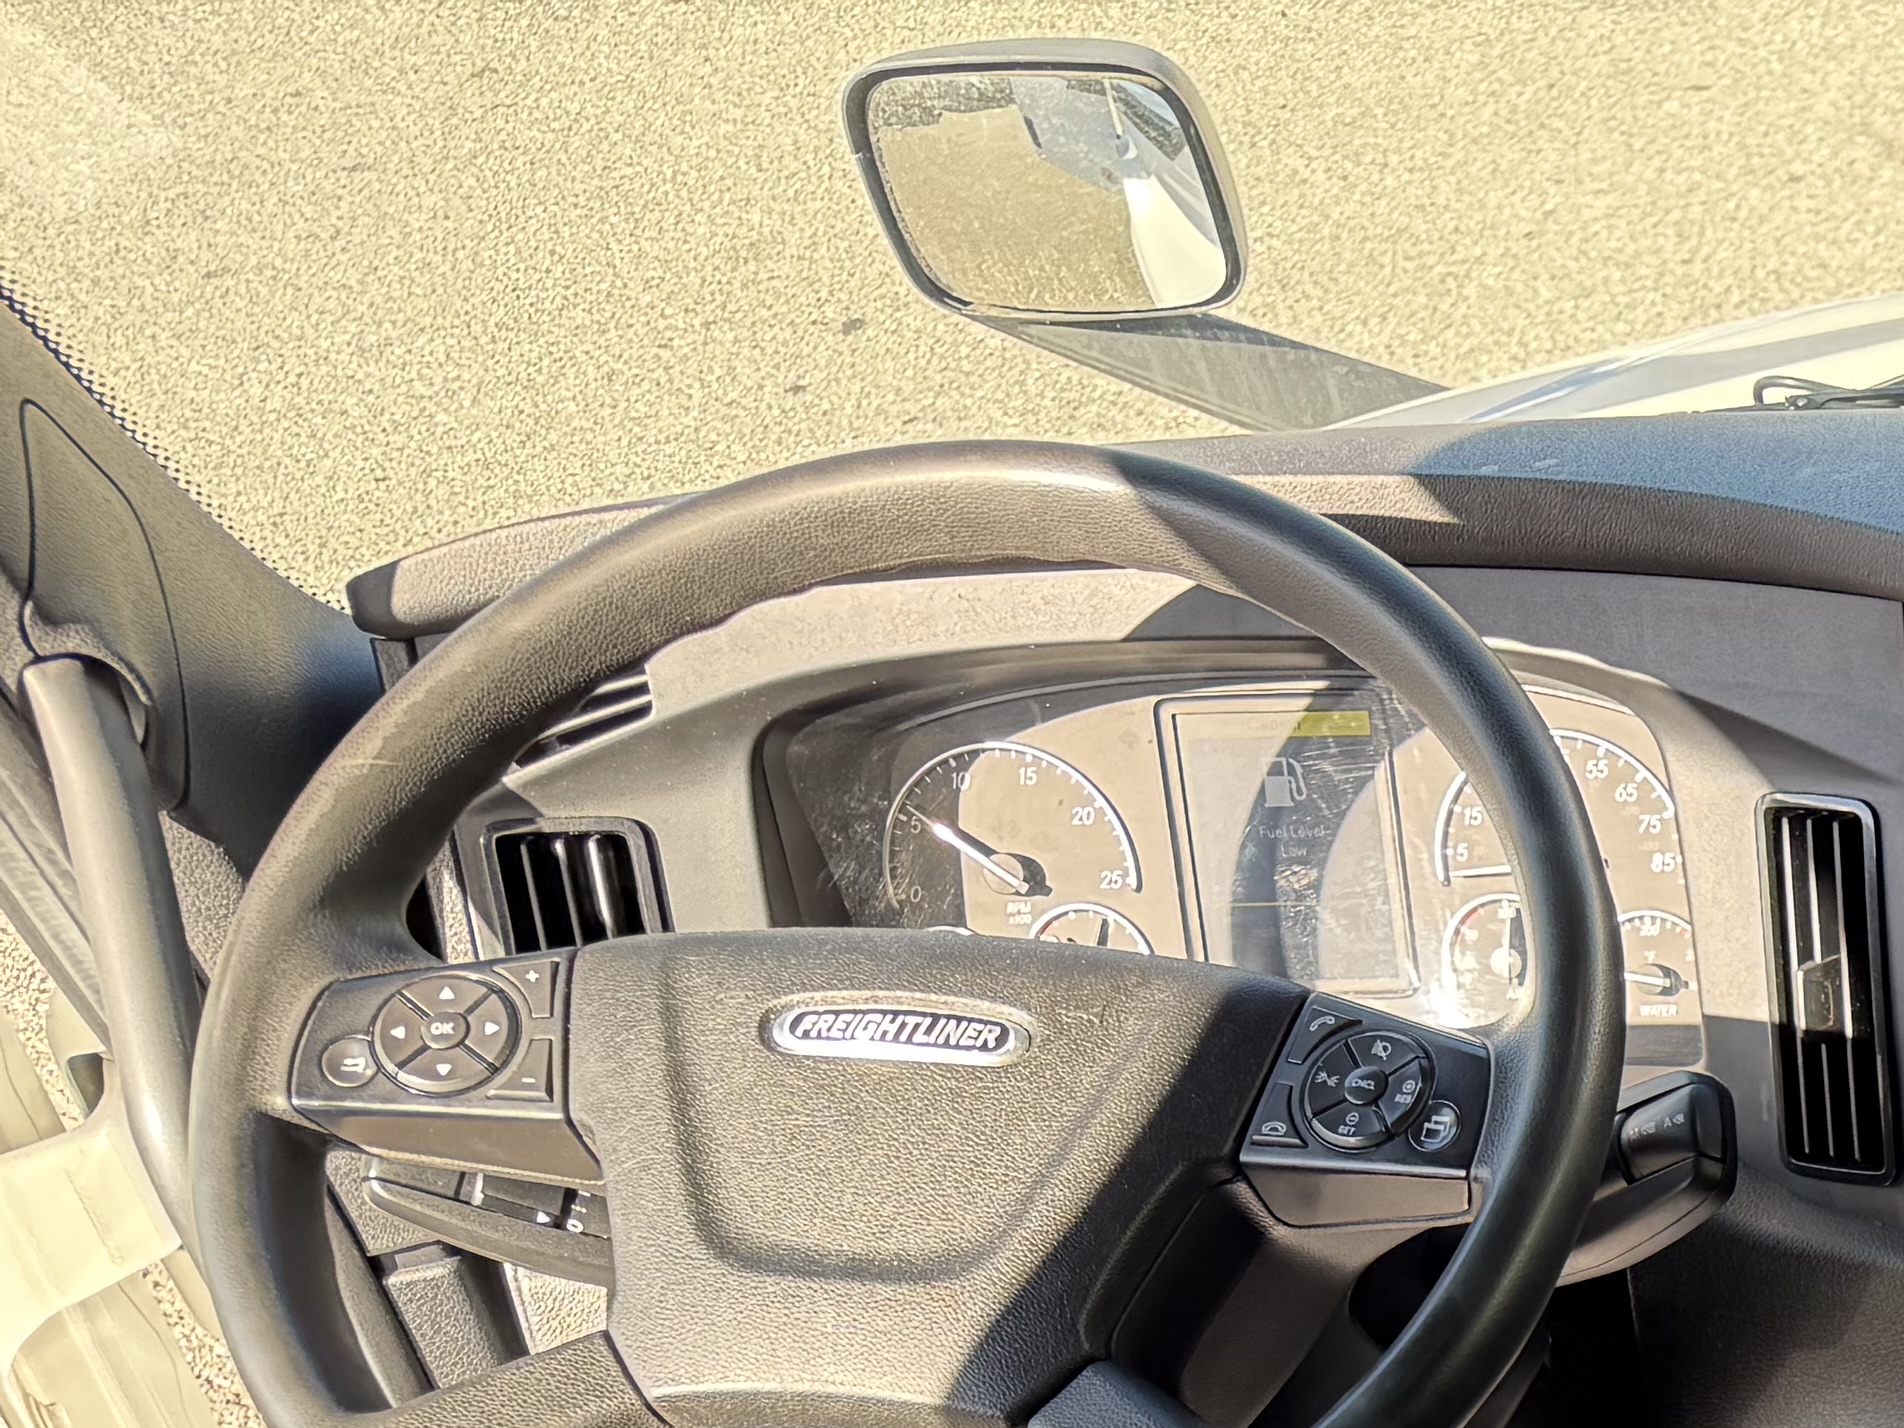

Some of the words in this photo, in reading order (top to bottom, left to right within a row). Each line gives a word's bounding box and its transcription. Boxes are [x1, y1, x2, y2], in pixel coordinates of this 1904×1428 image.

[1019, 767, 1037, 785] 15
[1585, 760, 1608, 779] 55
[951, 773, 970, 790] 10
[1615, 784, 1637, 802] 65
[910, 816, 921, 833] 5
[1072, 807, 1094, 825] 20
[1464, 807, 1482, 825] 15
[1638, 815, 1661, 833] 75
[1456, 843, 1468, 861] 5
[1651, 853, 1675, 872] 85
[1100, 871, 1122, 889] 25
[910, 886, 921, 902] 0
[1006, 902, 1031, 914] RPM
[430, 1022, 454, 1035] OK
[794, 1012, 1001, 1049] FREIGHTLINER
